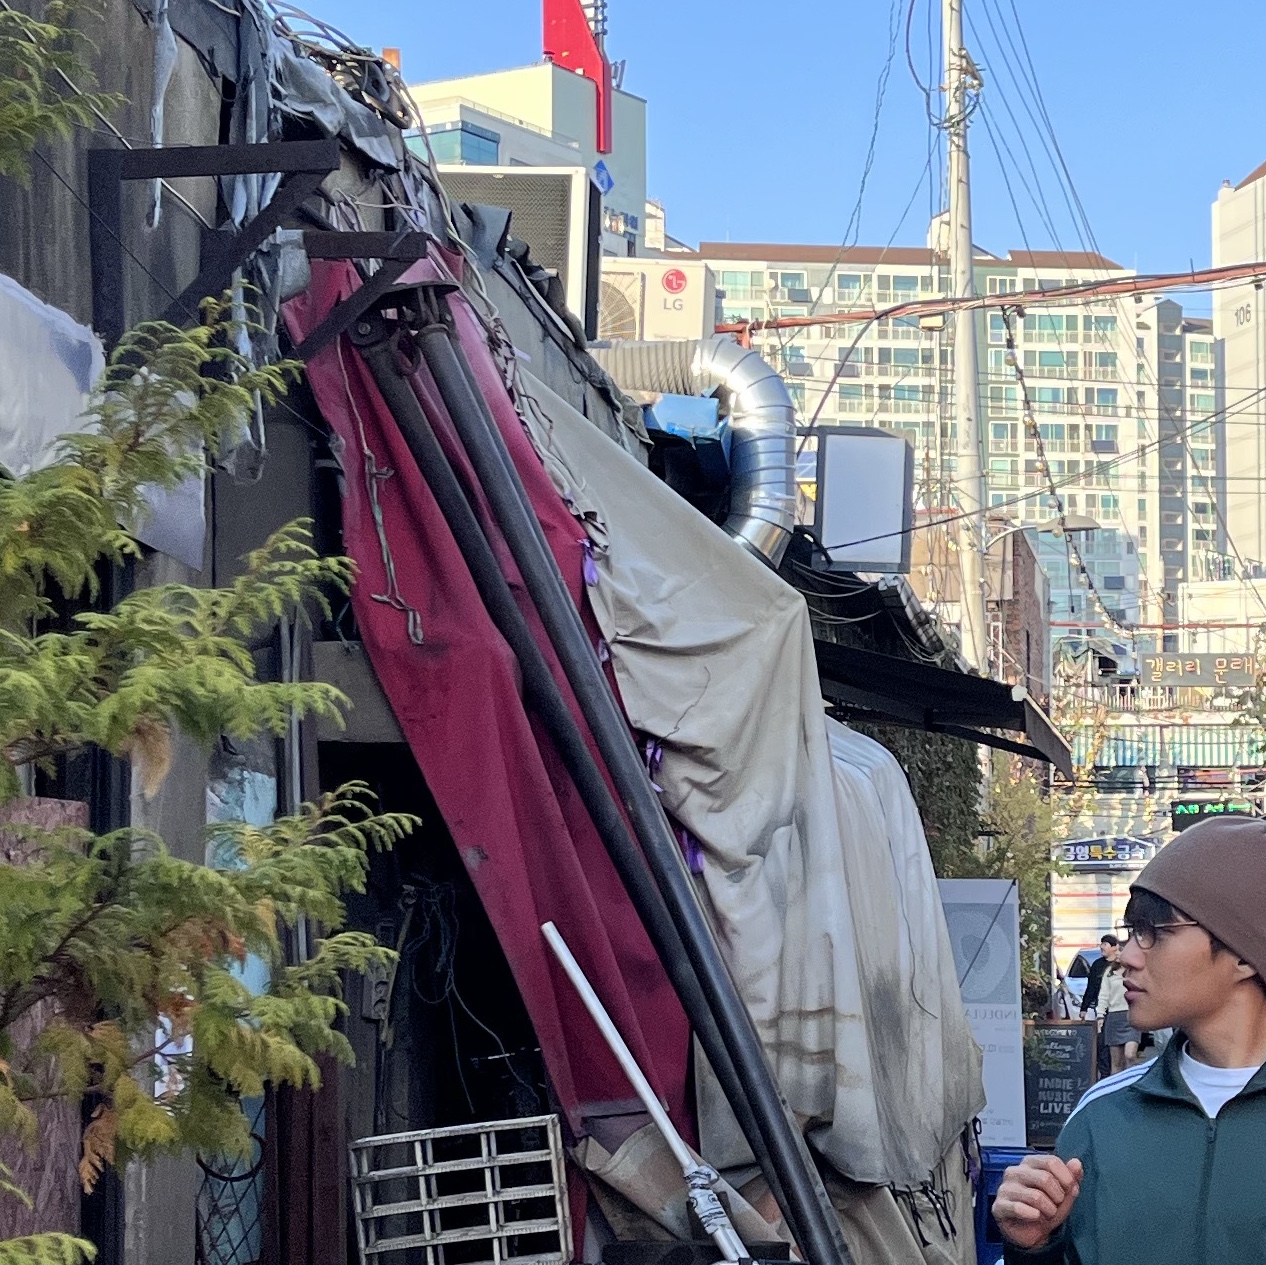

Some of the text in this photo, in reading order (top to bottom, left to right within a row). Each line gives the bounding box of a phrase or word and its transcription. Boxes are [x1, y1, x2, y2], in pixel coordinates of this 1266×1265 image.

[663, 298, 684, 311] LG
[1234, 302, 1252, 327] 106
[1145, 656, 1253, 684] 갤러리 문래
[1038, 1077, 1074, 1090] INDIE
[1039, 1102, 1072, 1114] LIVE
